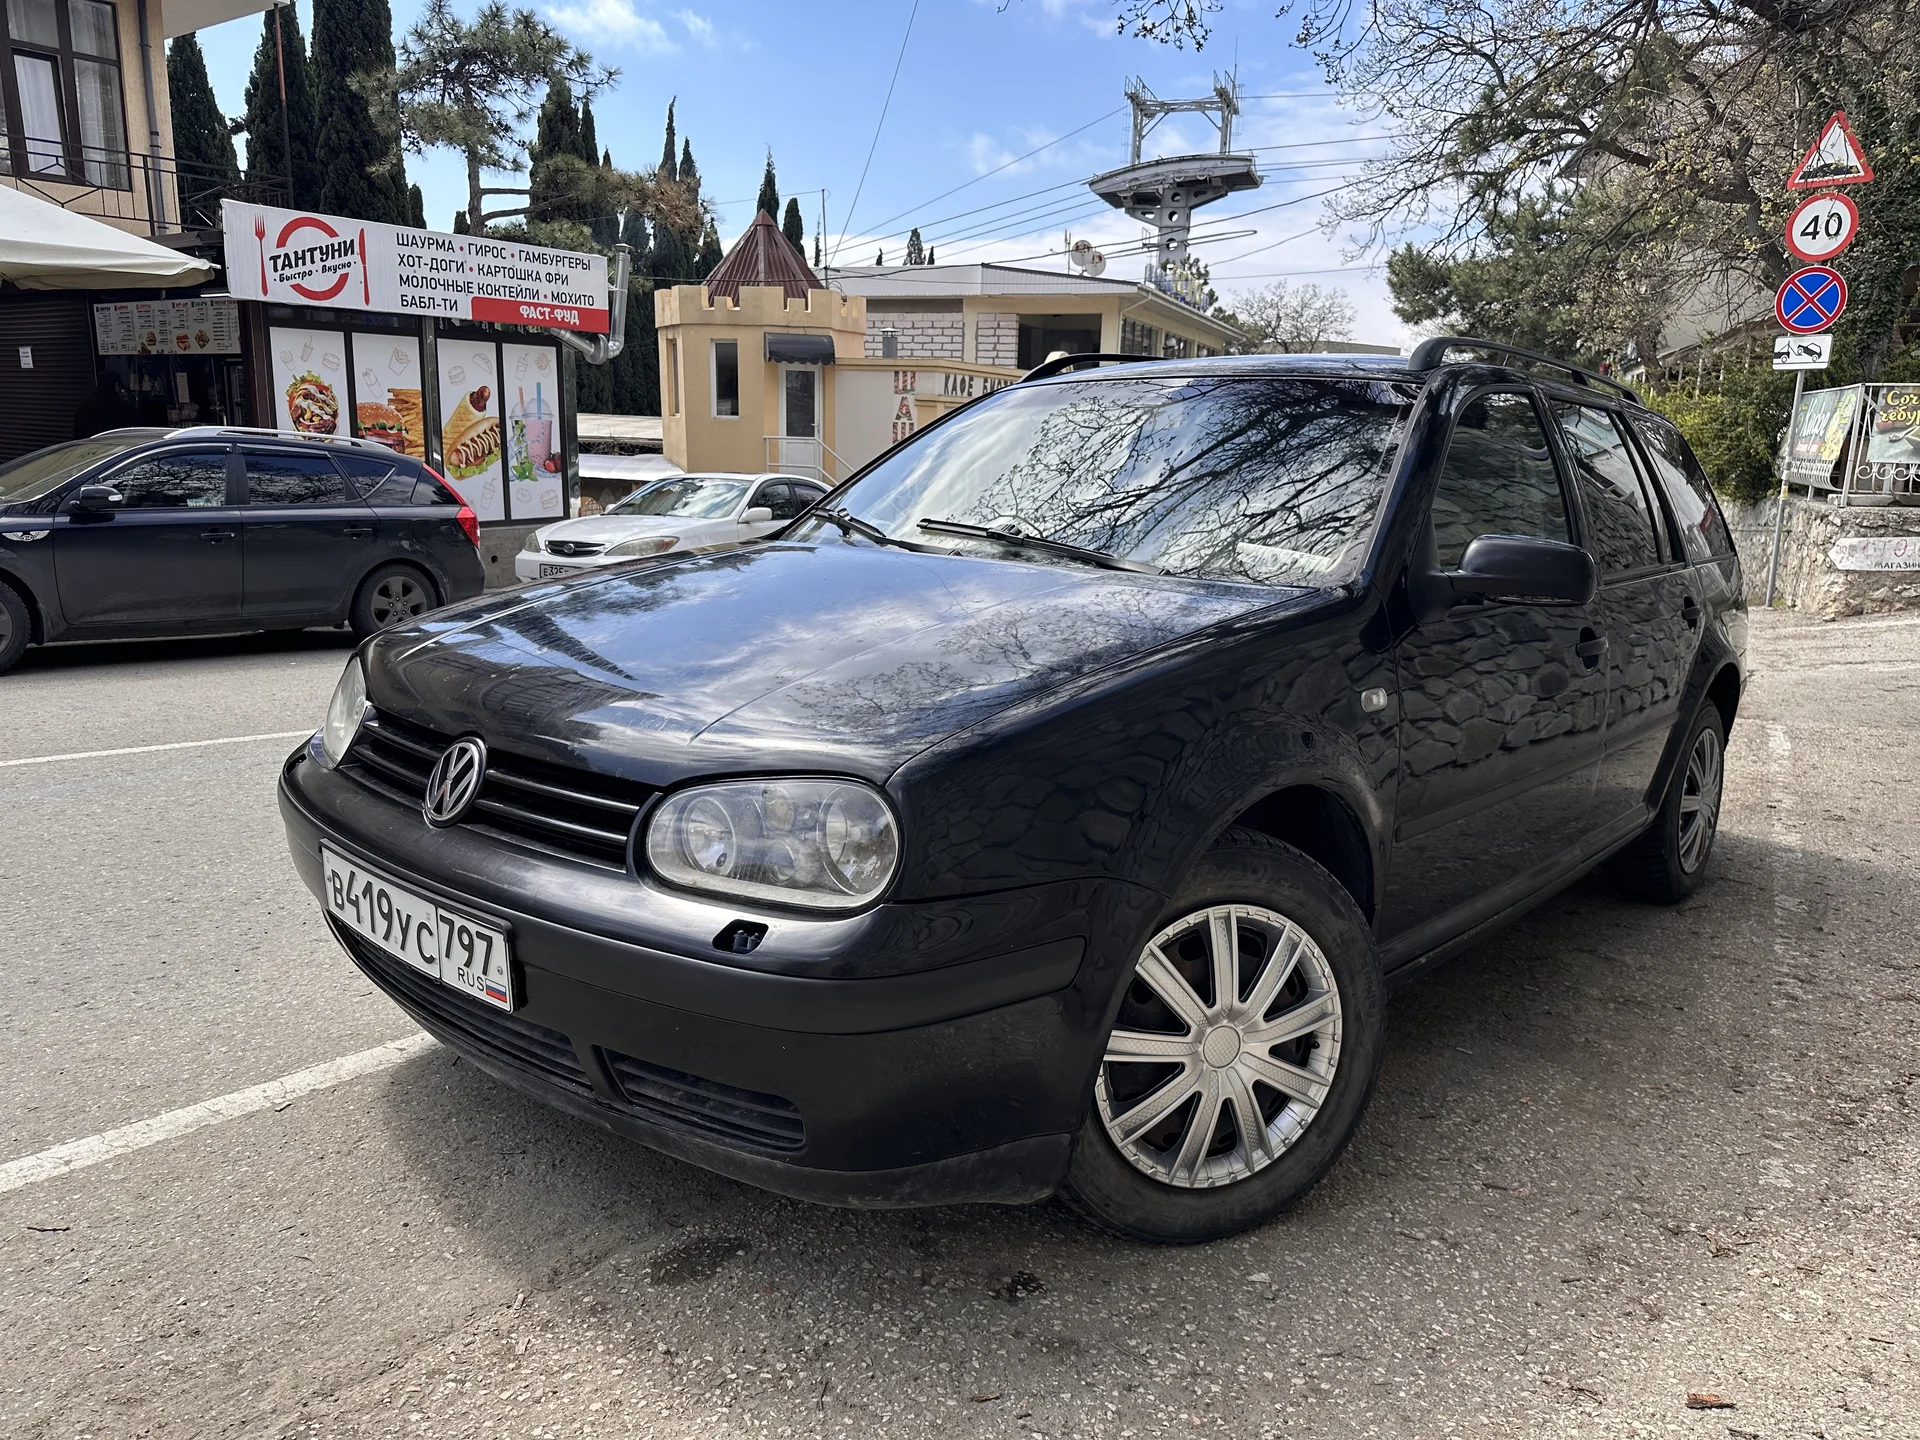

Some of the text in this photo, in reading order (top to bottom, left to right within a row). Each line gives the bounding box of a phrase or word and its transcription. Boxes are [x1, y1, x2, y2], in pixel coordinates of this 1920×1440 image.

[1799, 211, 1843, 241] 40
[269, 239, 355, 273] ТАНТУНИ
[396, 232, 591, 271] ШАУРМА ГИРОС ГАМБУРГЕРЫ
[279, 261, 352, 283] Быстро Вкусно
[397, 252, 569, 287] ХОТ-ДОГИ КАРТОШКА ФРИ
[399, 273, 595, 307] МОЛОЧНЫЕ КОКТЕЙЛИ МОХИТО
[400, 294, 458, 312] БАБЛ-ТИ
[519, 305, 580, 326] ФАСТ-ФУД
[943, 372, 975, 397] КАФЕ
[331, 868, 493, 976] В419УС 797
[457, 966, 485, 993] RUS
